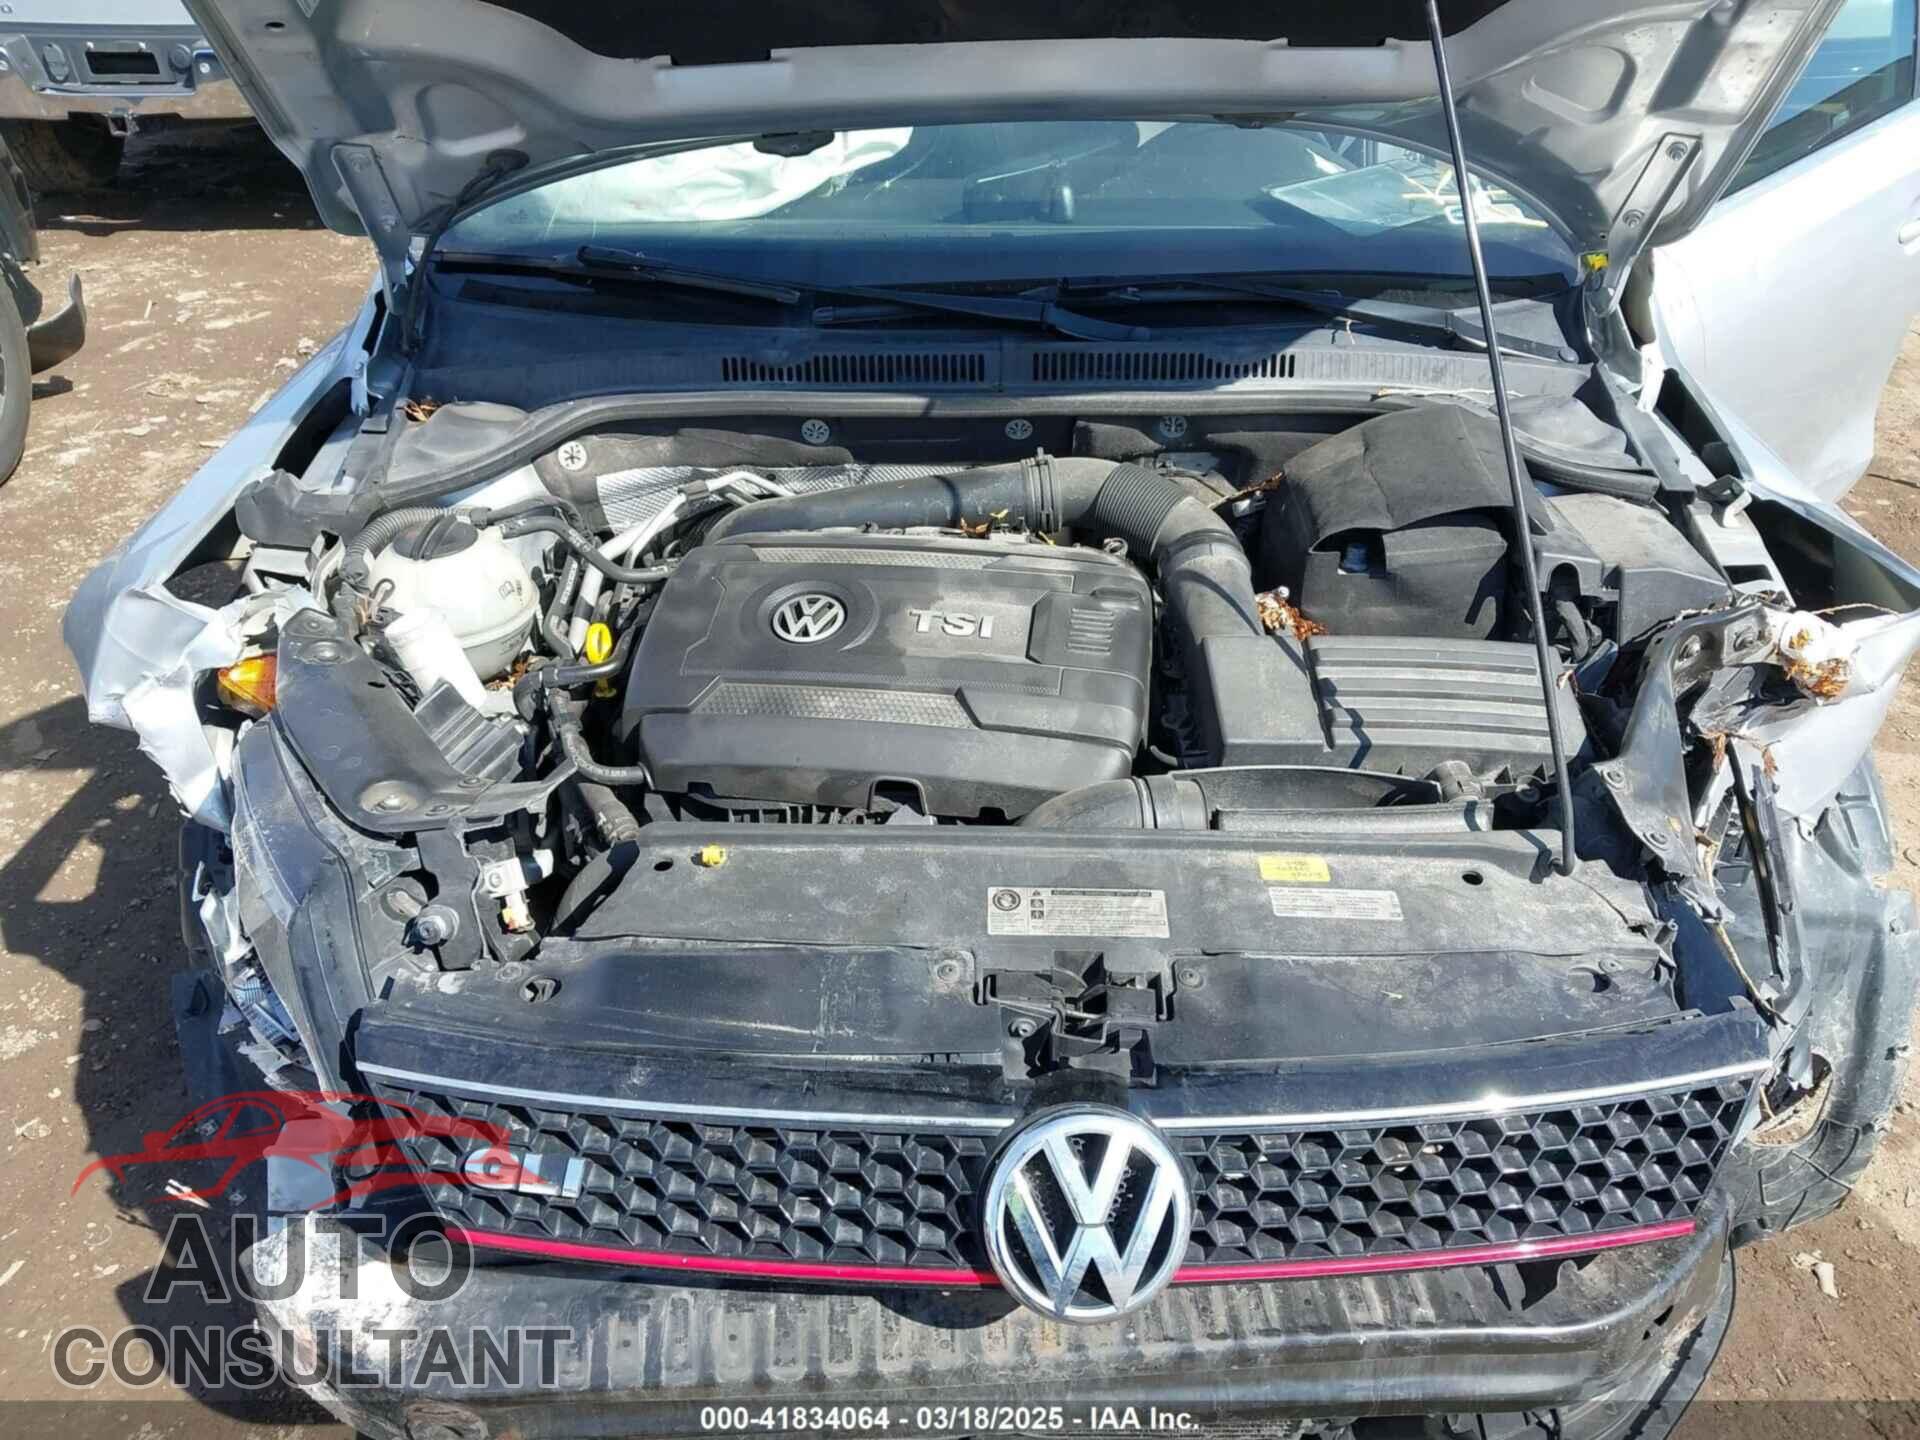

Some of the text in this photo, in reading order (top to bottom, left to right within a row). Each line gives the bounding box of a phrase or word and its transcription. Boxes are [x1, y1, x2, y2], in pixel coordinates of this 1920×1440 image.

[909, 608, 994, 639] TSI
[464, 1148, 585, 1199] GLI
[984, 1111, 1190, 1319] VW
